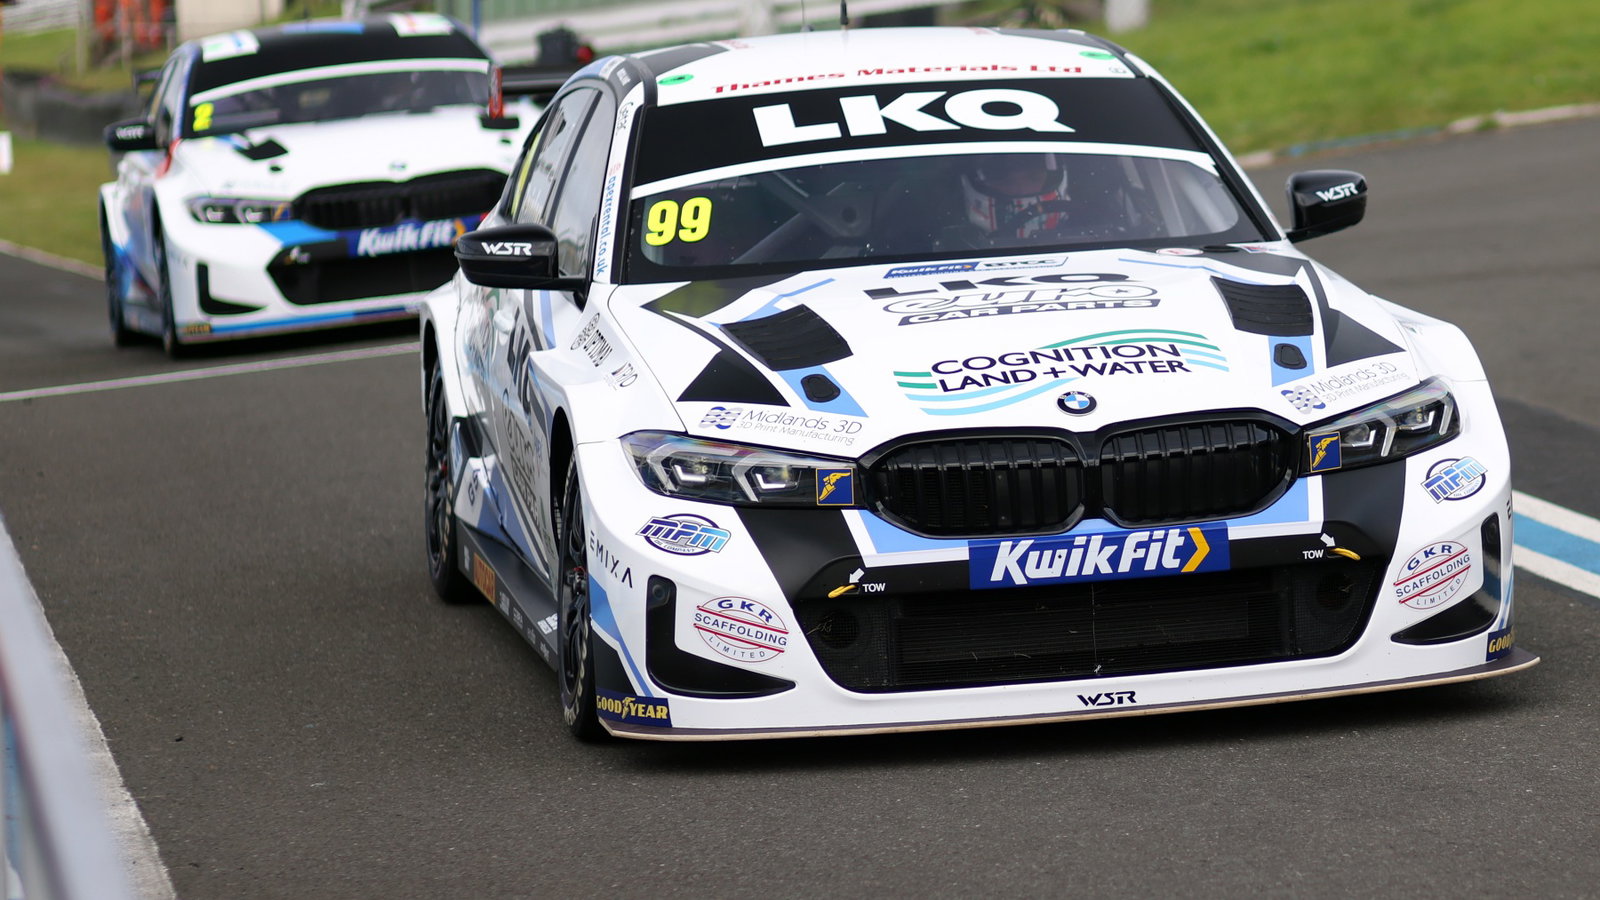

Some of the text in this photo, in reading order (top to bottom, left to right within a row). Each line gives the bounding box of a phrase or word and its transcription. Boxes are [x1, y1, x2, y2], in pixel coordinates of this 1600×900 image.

[713, 65, 1081, 93] Thames Materials Ltd
[193, 102, 215, 131] 2
[752, 88, 1076, 147] LKQ
[1315, 182, 1359, 201] WSR
[645, 196, 713, 247] 99
[481, 242, 532, 256] WSR
[863, 272, 1141, 300] LKQ
[908, 299, 1153, 324] CAR PARTS
[931, 344, 1182, 375] COGNITION
[1310, 361, 1398, 394] Midlands 3D
[736, 421, 855, 446] 3D Print Manufacturing
[742, 410, 863, 435] Midlands 3D
[1302, 549, 1324, 559] TOW
[1407, 544, 1453, 572] GKR
[862, 583, 886, 593] TOW
[1395, 553, 1471, 598] SCAFFOLDING
[1416, 578, 1462, 606] LIMITED
[718, 599, 773, 625] GKR
[694, 612, 788, 647] SCAFFOLDING
[708, 635, 766, 659] LIMITED
[597, 695, 668, 719] GOODYEAR
[1077, 691, 1137, 707] WSR
